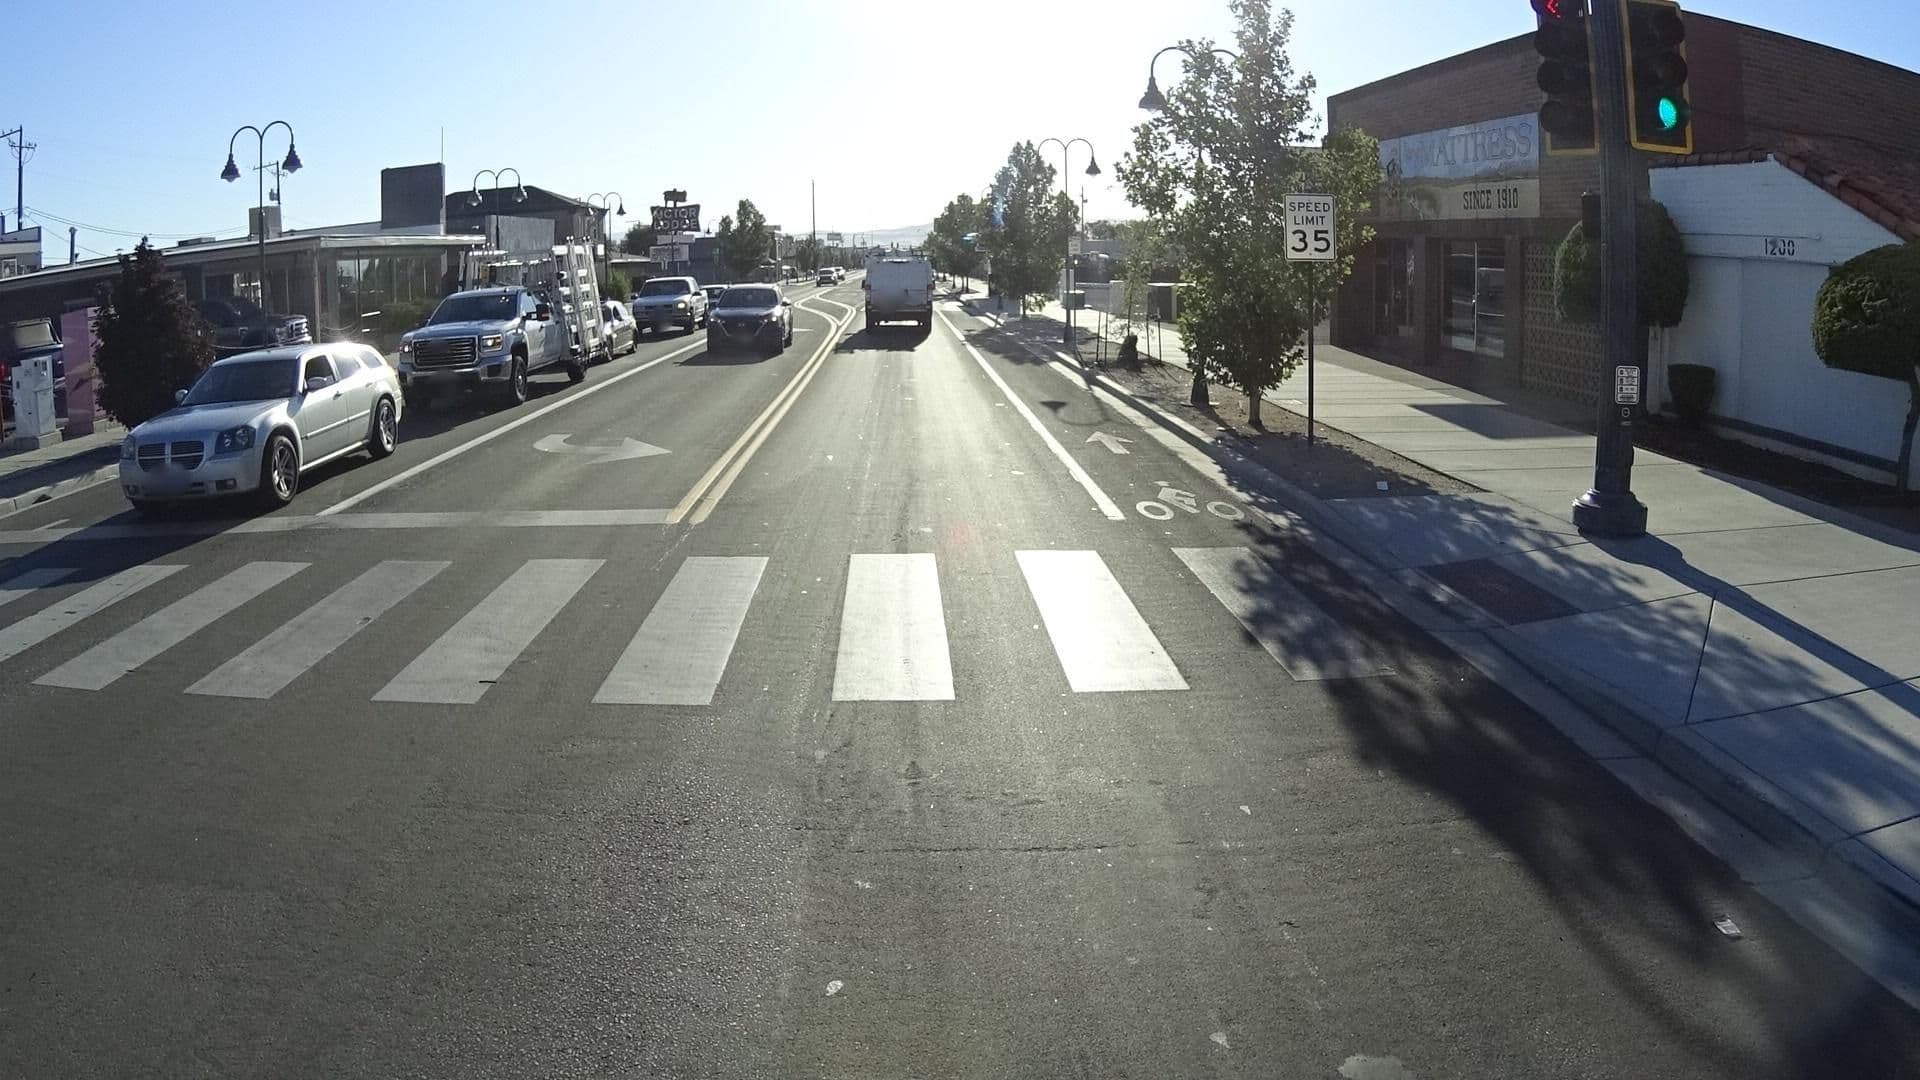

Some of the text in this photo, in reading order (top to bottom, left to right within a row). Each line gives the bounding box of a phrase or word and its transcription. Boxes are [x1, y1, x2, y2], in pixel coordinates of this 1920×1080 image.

[1288, 202, 1331, 213] SPEED
[1463, 188, 1519, 210] SINCE 1910
[1293, 215, 1326, 226] LIMIT
[1291, 229, 1331, 253] 35
[1764, 237, 1795, 256] 1200
